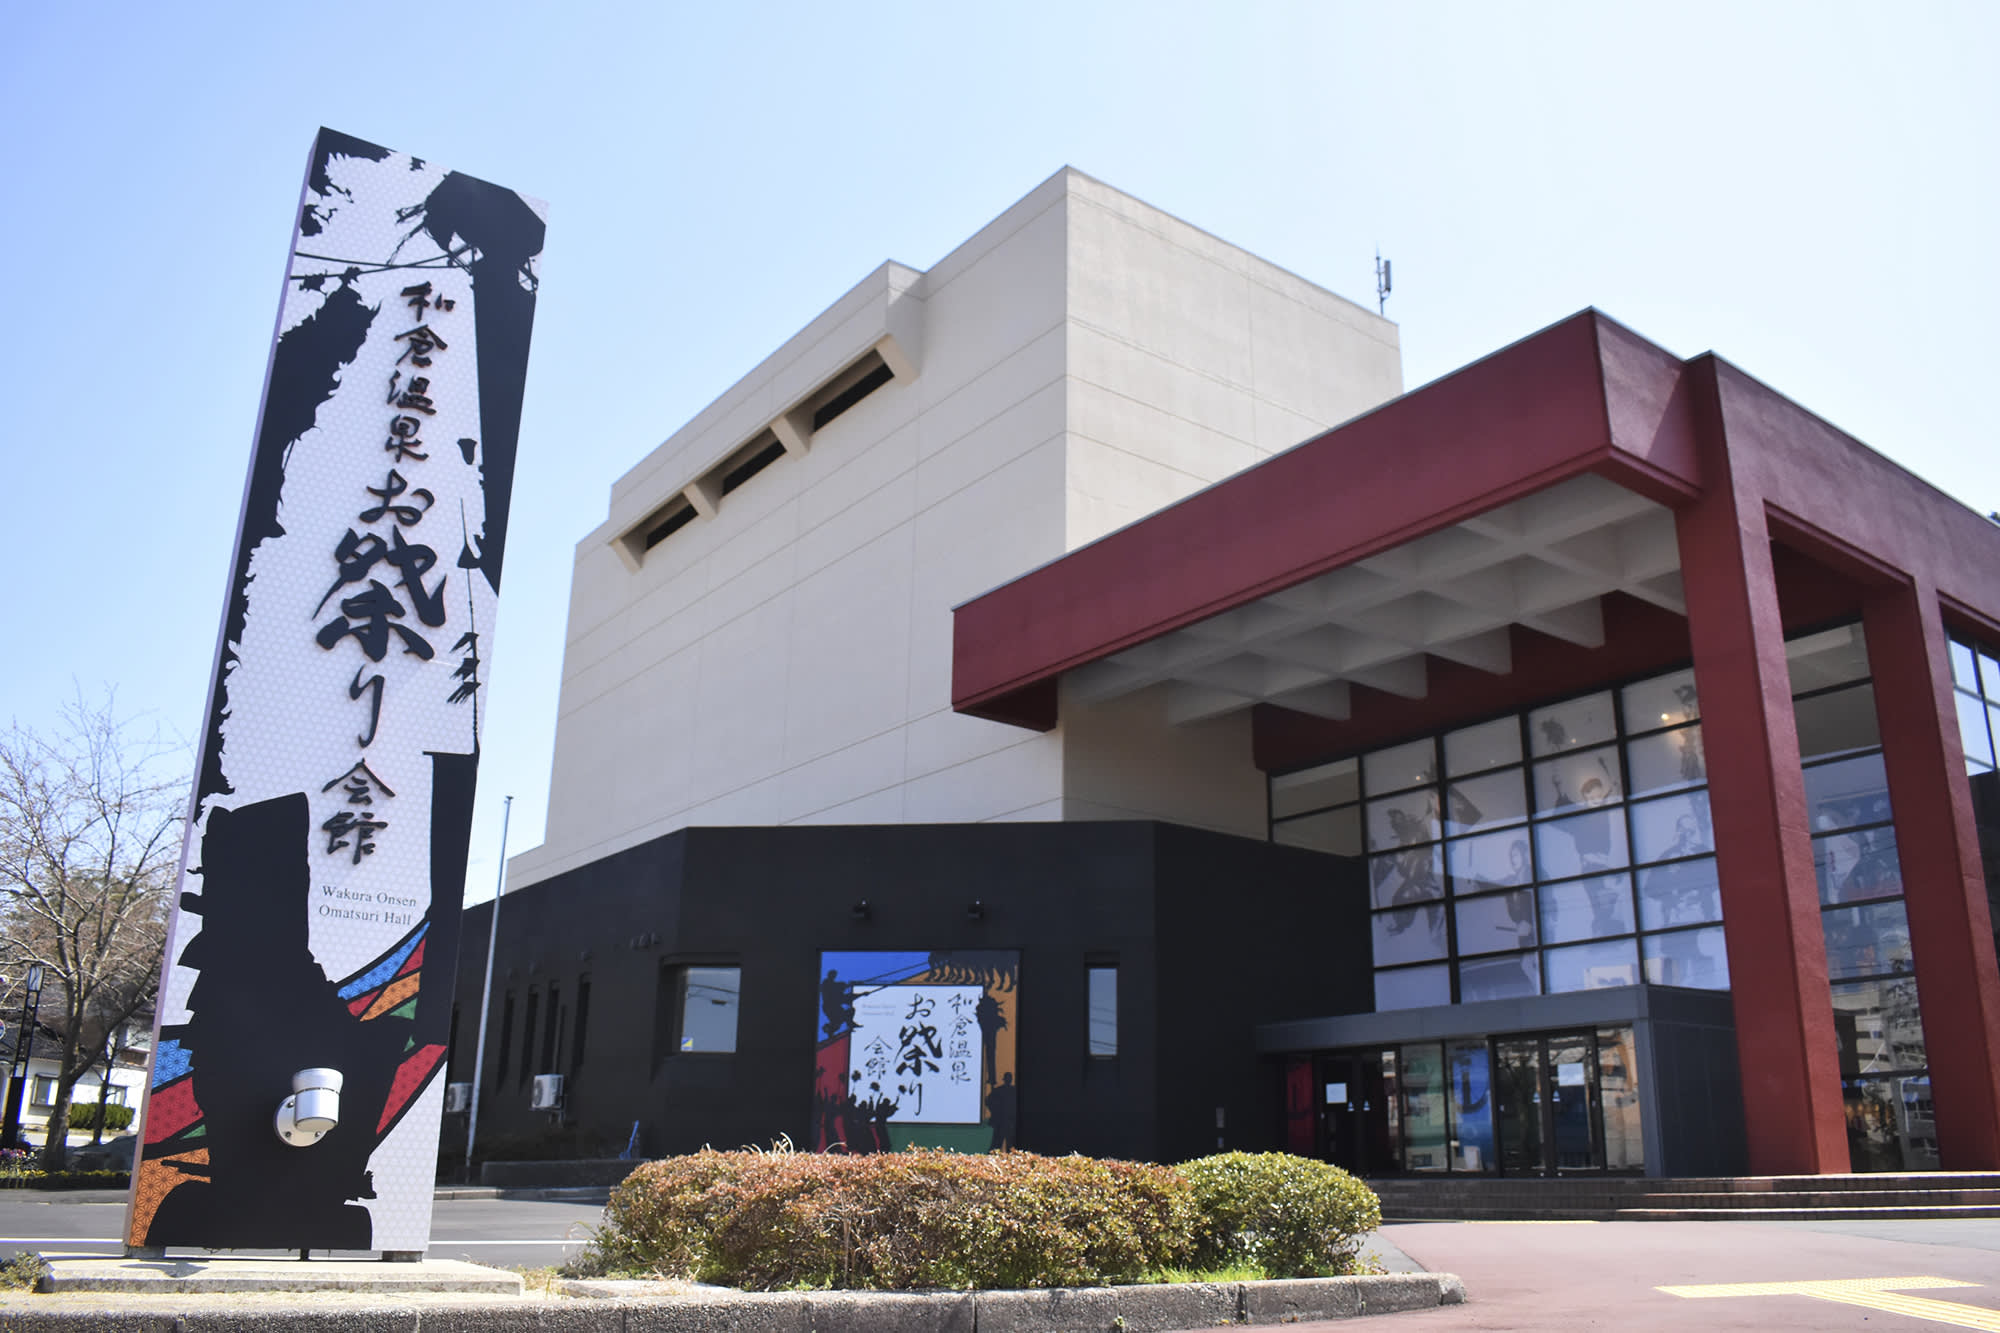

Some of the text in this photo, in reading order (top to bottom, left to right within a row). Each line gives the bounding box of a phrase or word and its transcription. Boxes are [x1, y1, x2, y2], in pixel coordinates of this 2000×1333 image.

[319, 904, 412, 926] Omatsuri Hall
[322, 885, 417, 908] Wakura Onsen
[864, 1035, 893, 1080] 会館
[894, 992, 943, 1116] お祭り
[947, 993, 973, 1085] 和倉温泉
